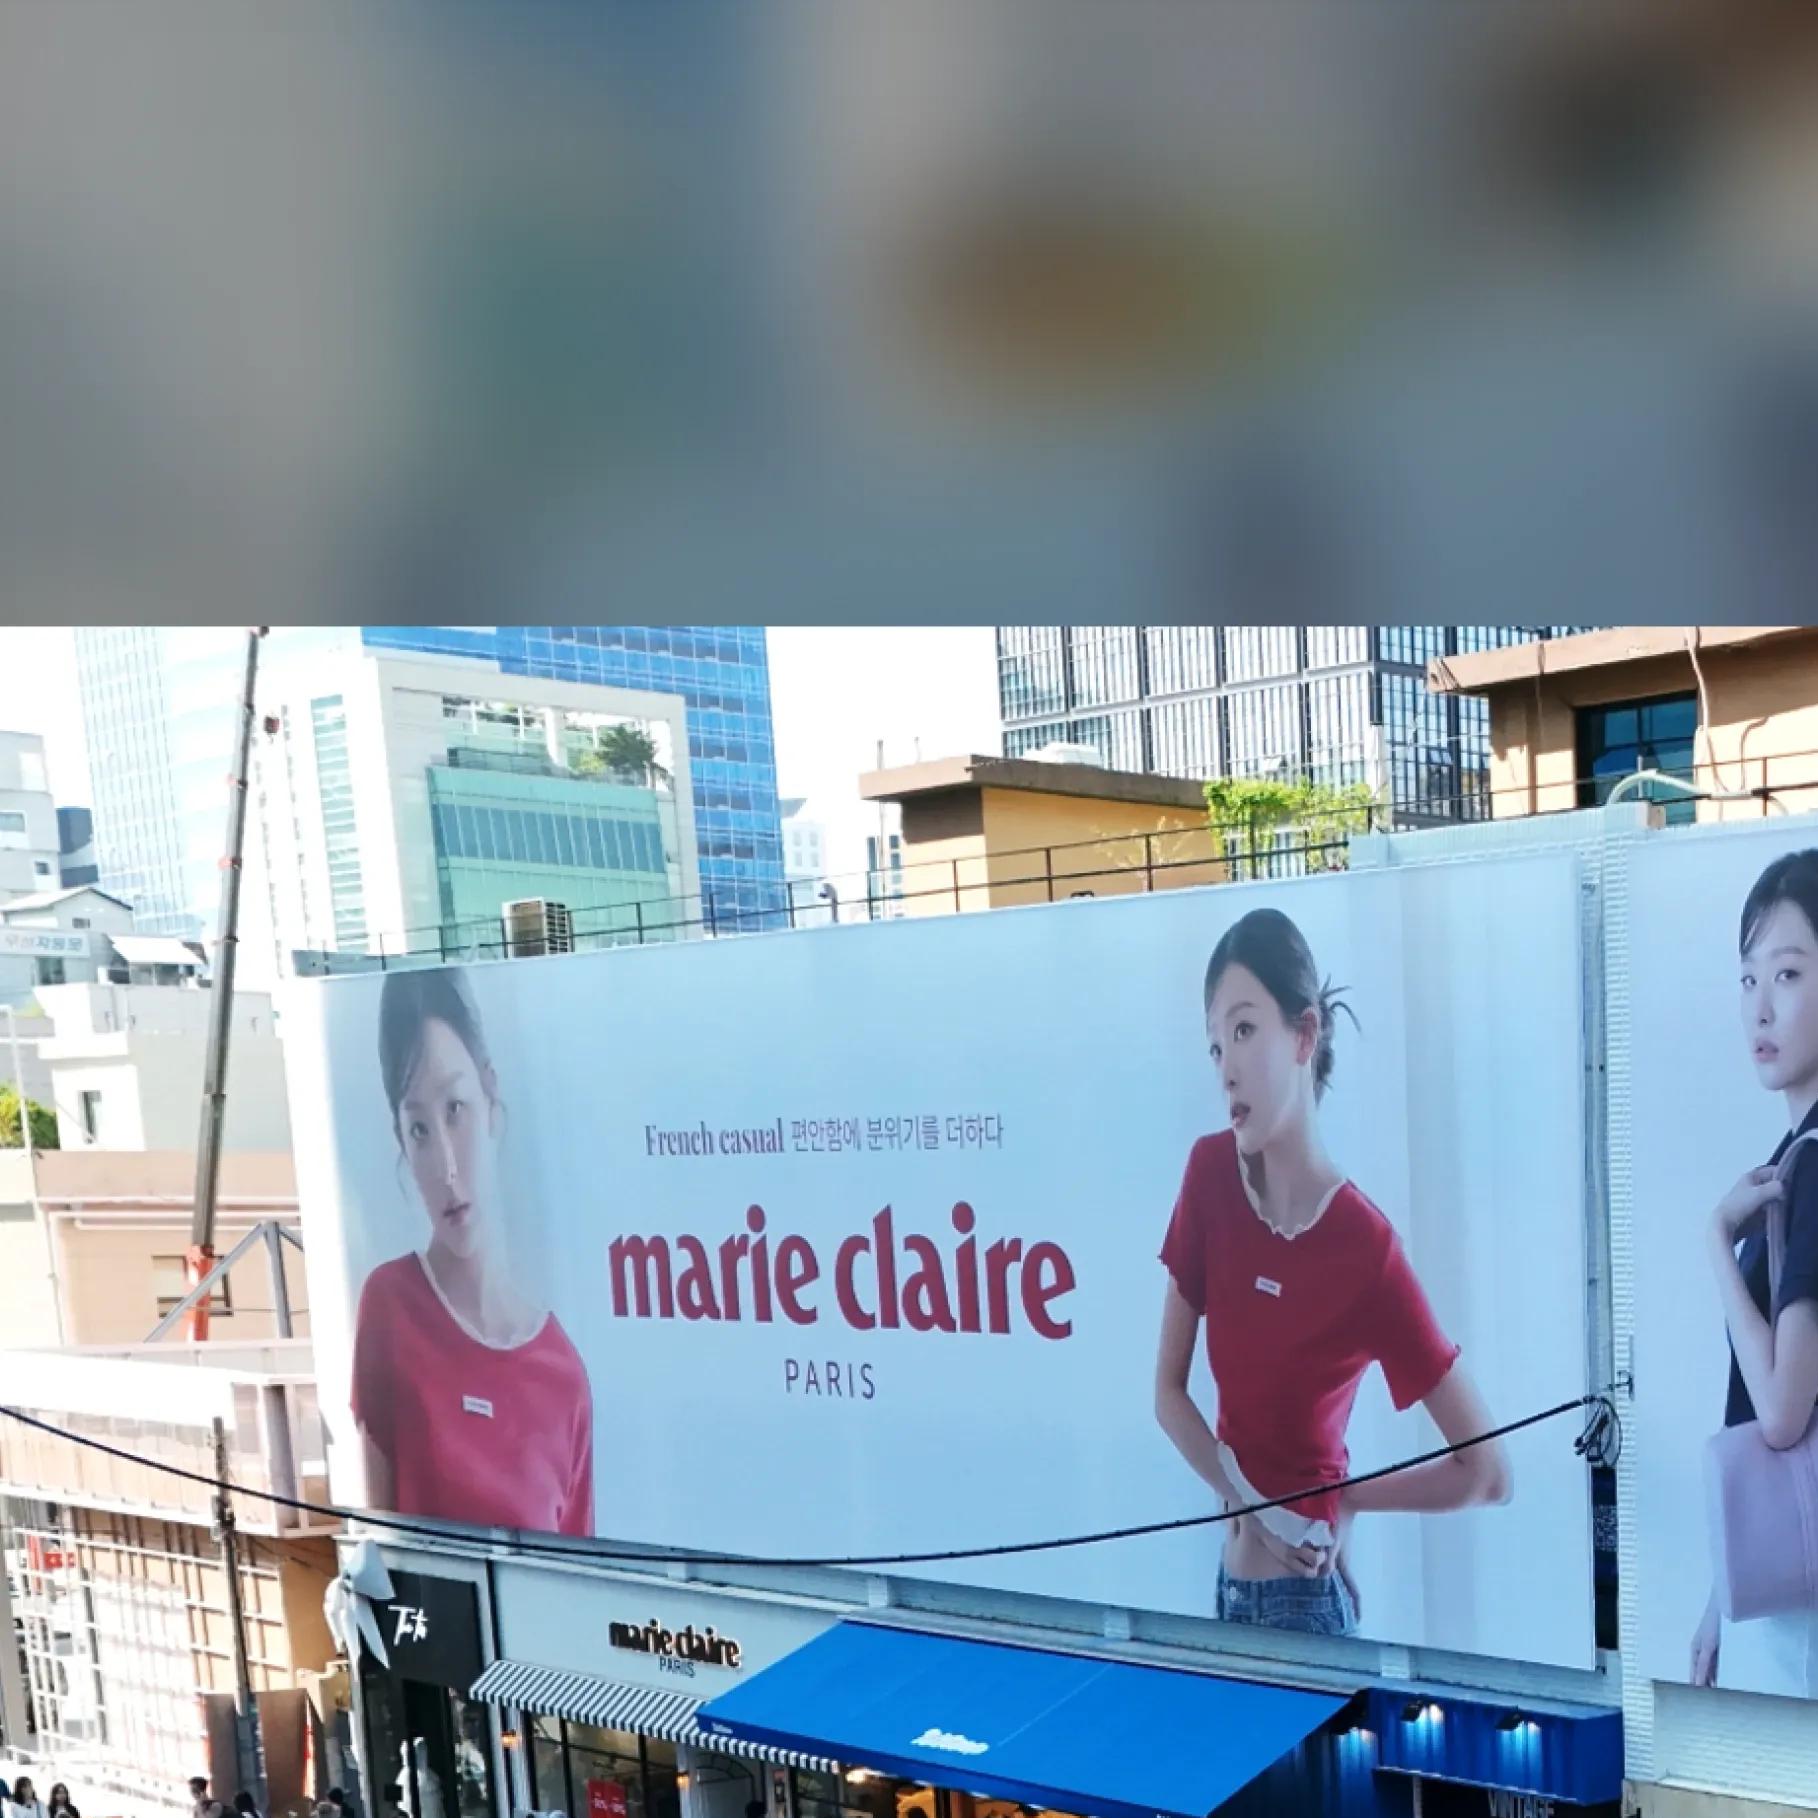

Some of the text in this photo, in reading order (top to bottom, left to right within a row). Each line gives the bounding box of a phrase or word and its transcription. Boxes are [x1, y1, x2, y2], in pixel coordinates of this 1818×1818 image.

[645, 1113, 1004, 1156] French casual 편안함에 분위기를 더하다
[608, 1200, 1077, 1340] marie claire
[785, 1358, 876, 1400] PARIS
[609, 1618, 742, 1668] marie claire
[659, 1655, 696, 1678] PARIS
